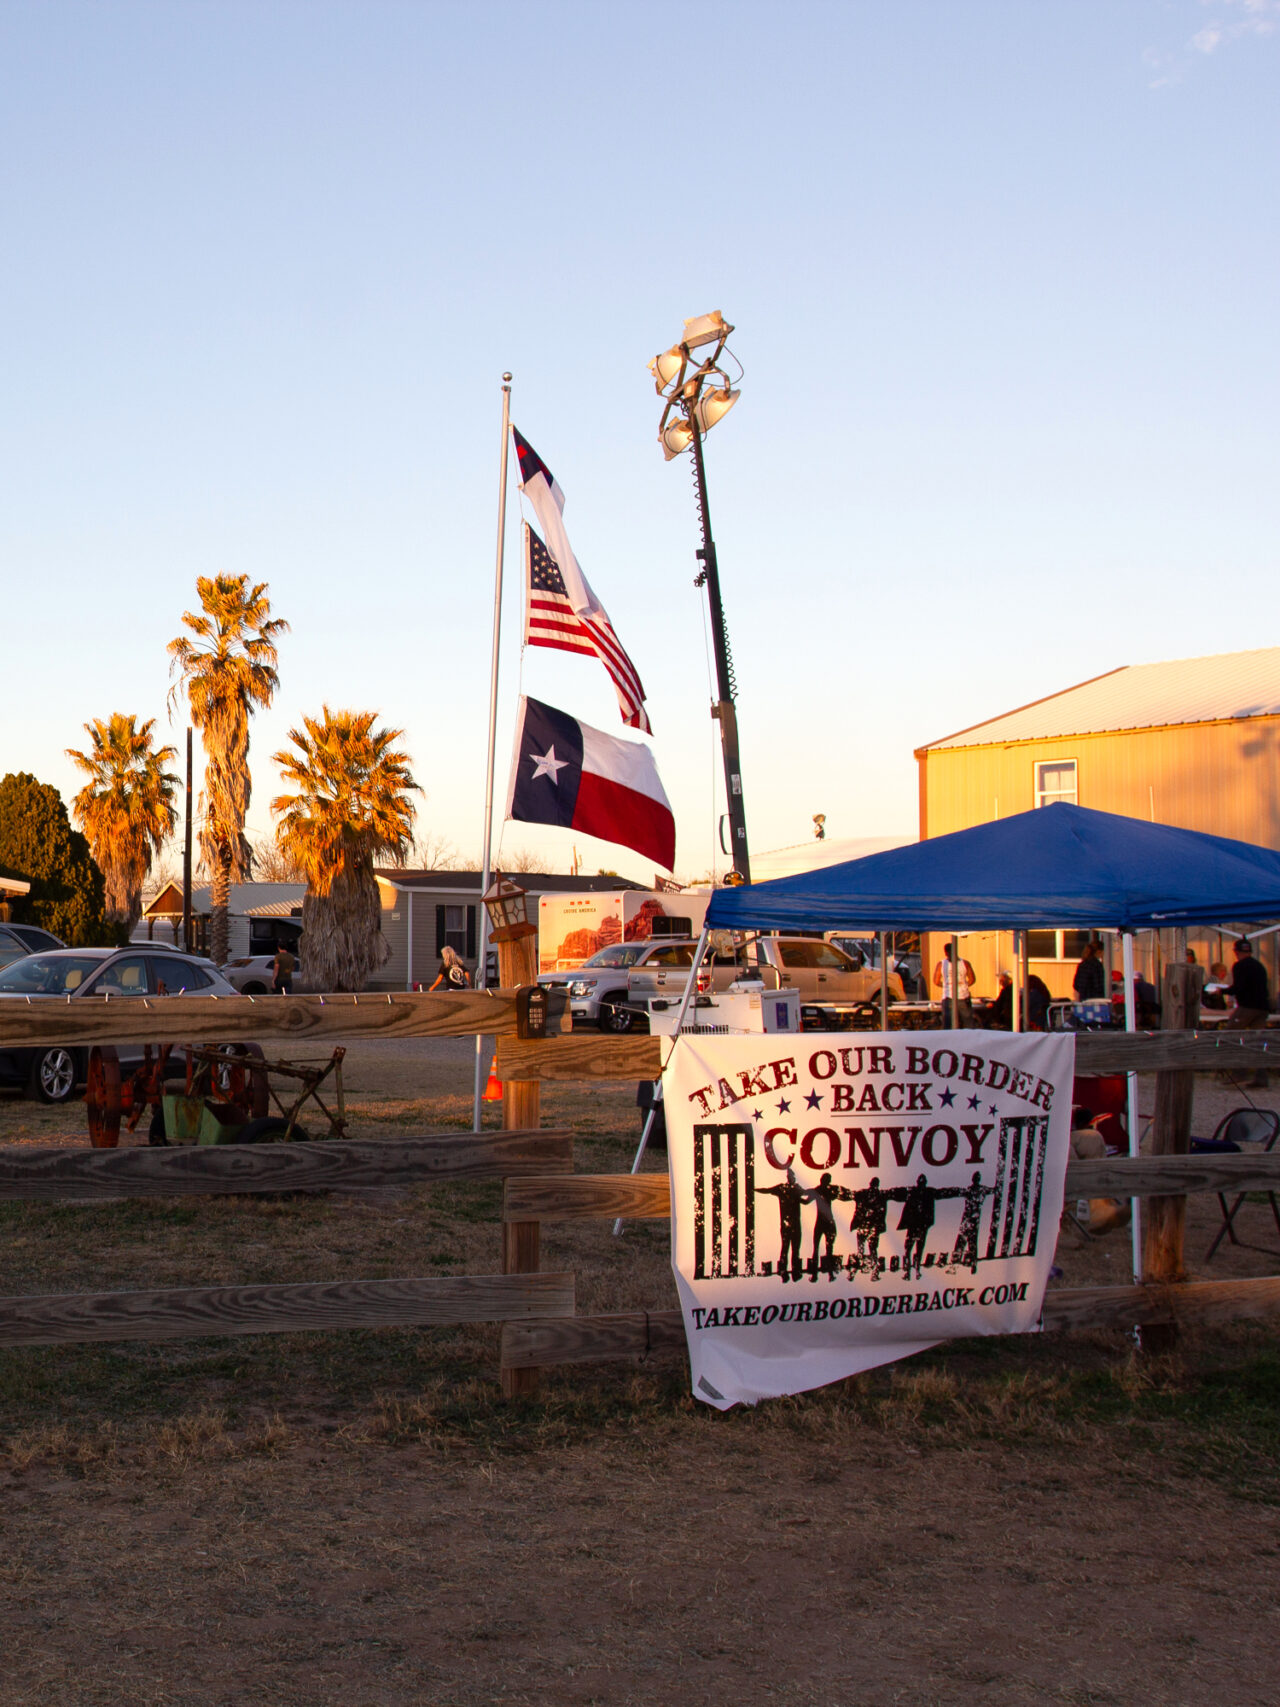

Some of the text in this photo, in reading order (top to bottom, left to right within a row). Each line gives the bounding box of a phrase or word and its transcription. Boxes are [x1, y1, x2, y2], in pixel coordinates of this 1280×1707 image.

[688, 1045, 1055, 1119] TAKE OUR BORDER
[831, 1083, 933, 1112] BACK
[763, 1123, 995, 1170] CONVOY
[692, 1283, 1029, 1330] TAKEOURBORDERBACK.COM
